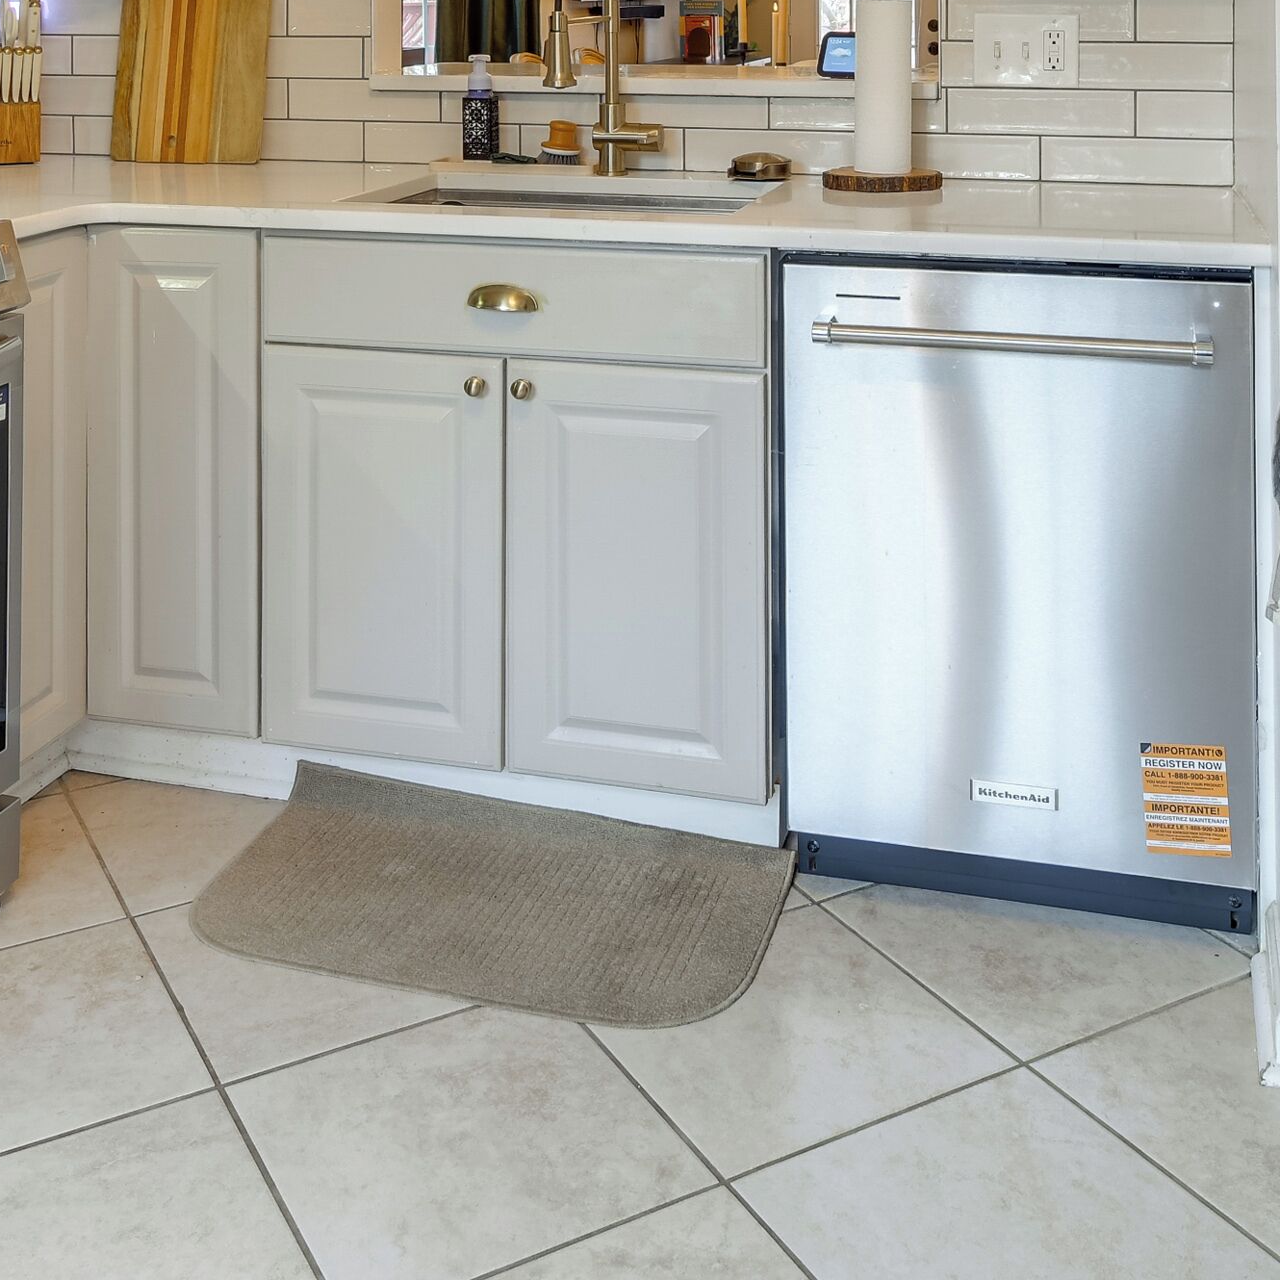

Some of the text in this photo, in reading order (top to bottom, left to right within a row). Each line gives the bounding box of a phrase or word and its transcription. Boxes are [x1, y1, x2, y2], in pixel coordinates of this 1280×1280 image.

[1152, 746, 1214, 757] IMPORTANT!
[1144, 758, 1222, 770] REGISTER NOW
[1144, 770, 1224, 781] CALL 1-888-900-3381
[978, 788, 1050, 804] KitchenAid
[1152, 804, 1220, 816] IMPORTANTE!
[1146, 814, 1188, 822] ENREGISTREZ
